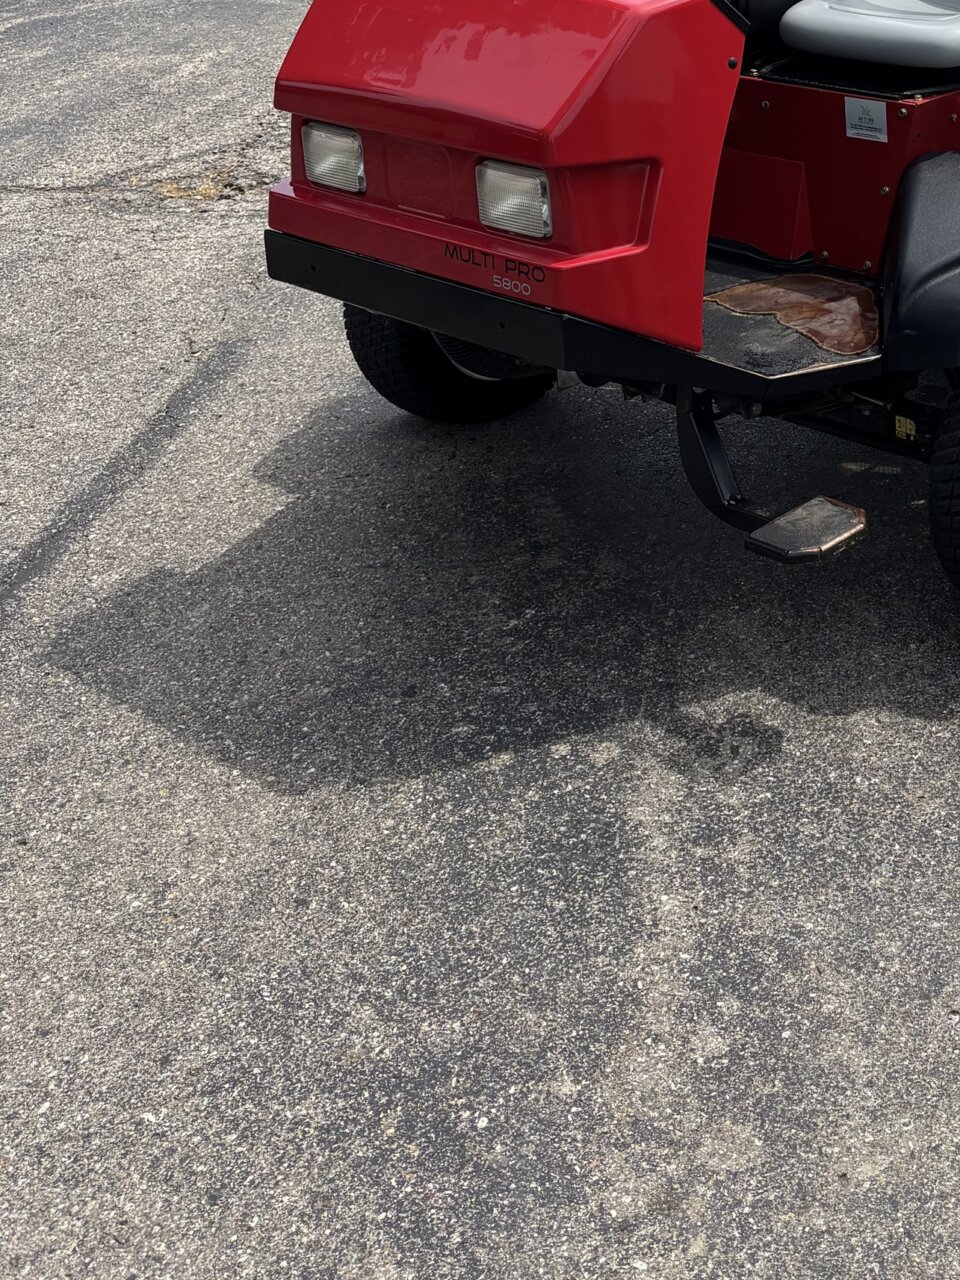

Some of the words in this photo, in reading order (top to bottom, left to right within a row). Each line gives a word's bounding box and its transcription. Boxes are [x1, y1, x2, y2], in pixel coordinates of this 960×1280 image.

[444, 243, 495, 271] MULTI
[505, 258, 546, 283] PRO
[492, 274, 532, 296] 5800
